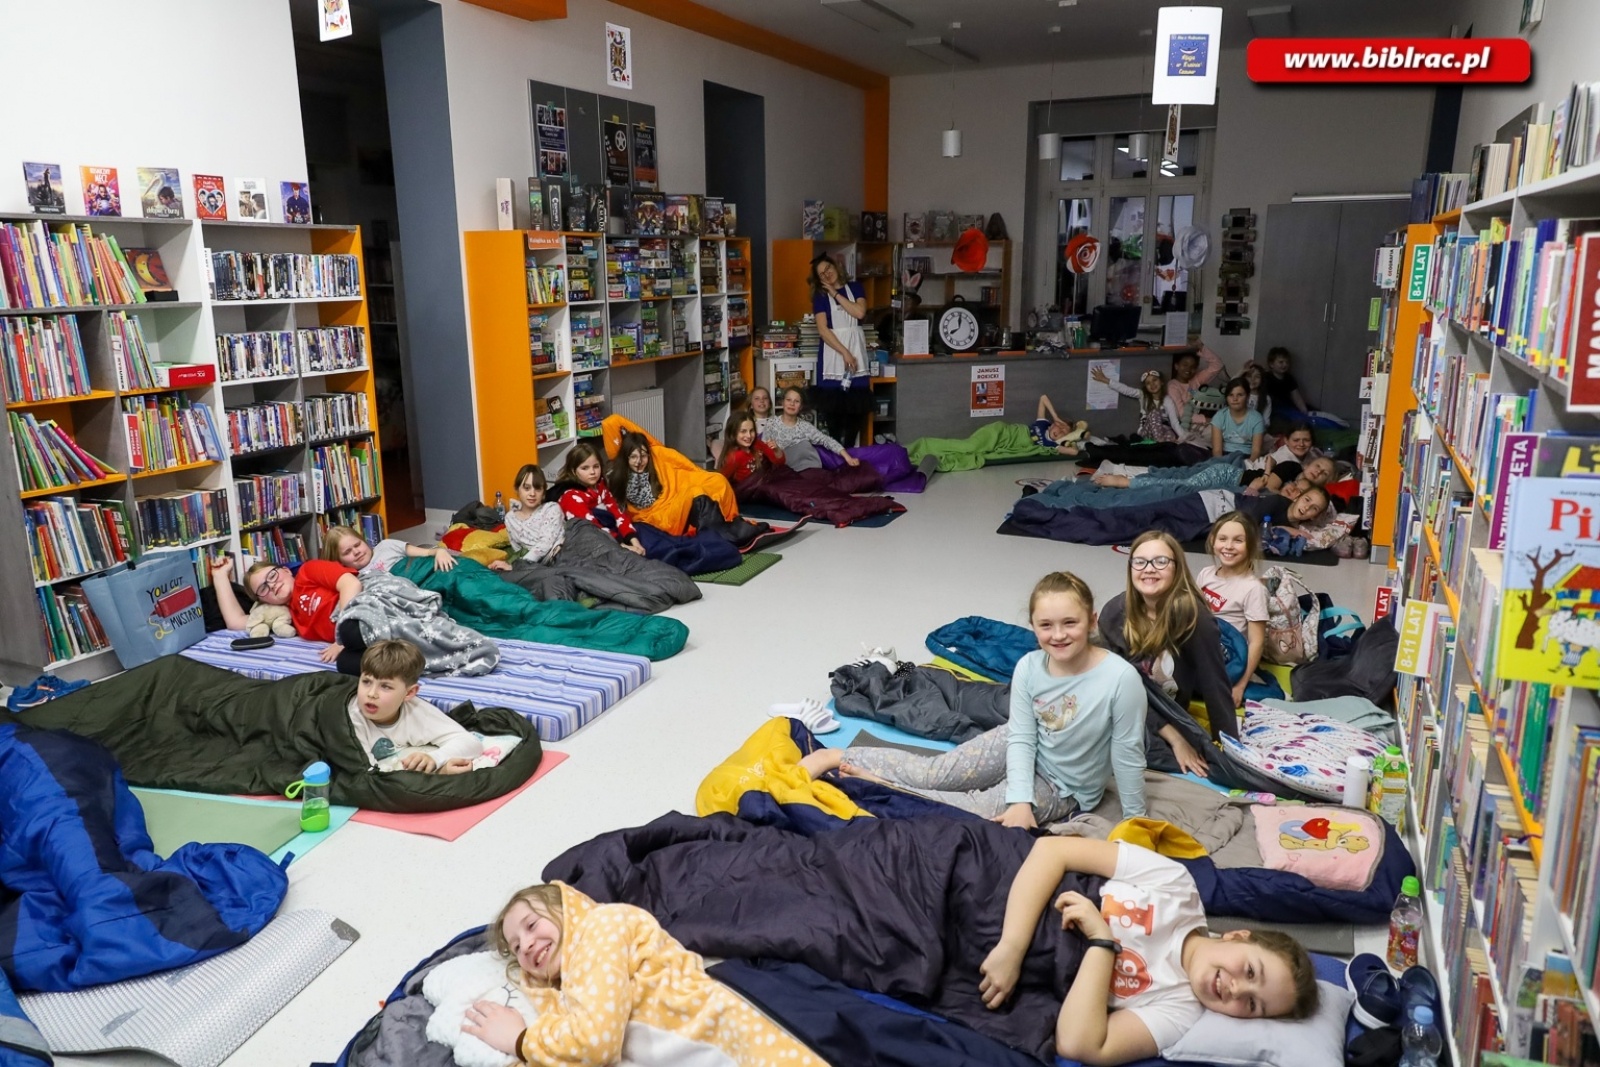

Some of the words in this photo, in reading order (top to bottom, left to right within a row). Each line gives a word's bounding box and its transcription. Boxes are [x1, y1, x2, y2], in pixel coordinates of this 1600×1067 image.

[1416, 249, 1427, 271] LAT
[1412, 273, 1424, 297] 8-11
[1586, 271, 1600, 379] MAN
[1499, 439, 1529, 538] ZWZĘTA
[1548, 498, 1600, 542] Pi
[146, 583, 168, 603] YOU
[169, 576, 184, 589] CUT
[1378, 590, 1391, 612] LAT
[169, 606, 203, 630] MUSTARD
[1407, 606, 1423, 635] LAT
[1400, 640, 1416, 668] 8-11
